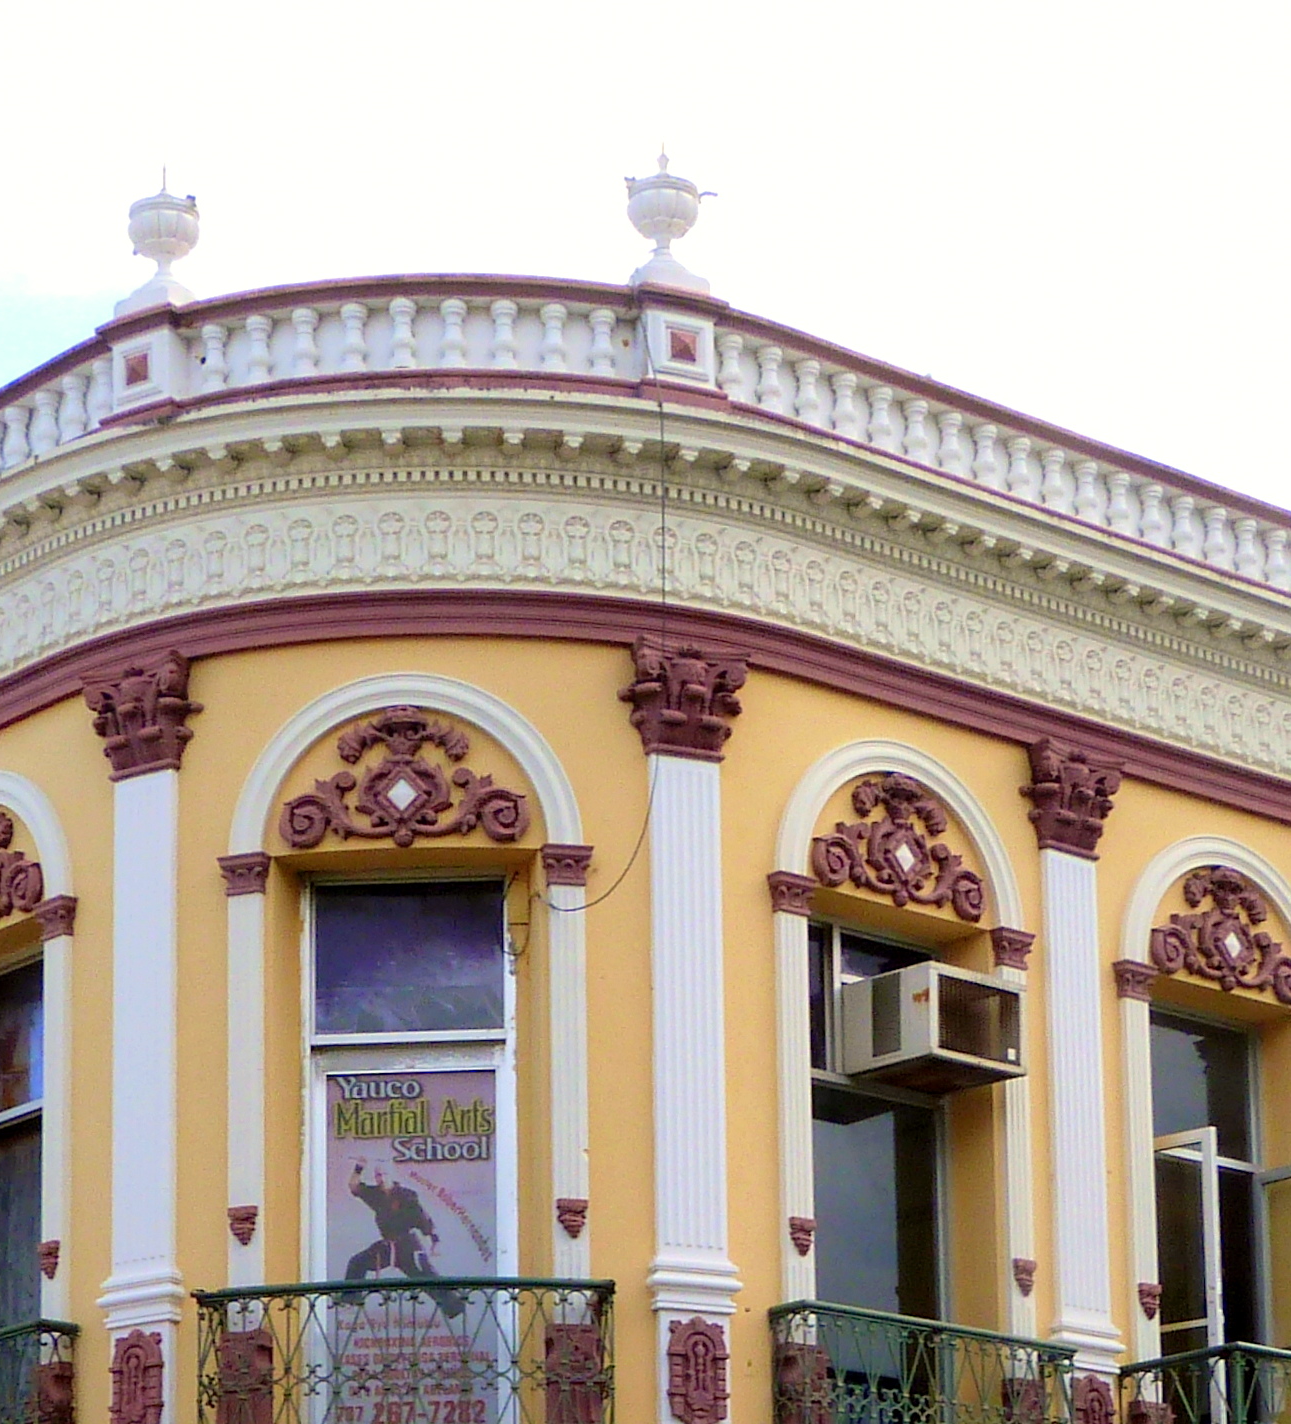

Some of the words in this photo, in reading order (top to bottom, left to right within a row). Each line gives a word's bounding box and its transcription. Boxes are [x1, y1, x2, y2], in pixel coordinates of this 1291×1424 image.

[335, 1075, 422, 1099] Yauco
[334, 1098, 429, 1138] Martial
[439, 1098, 495, 1136] Arts
[393, 1135, 490, 1162] School
